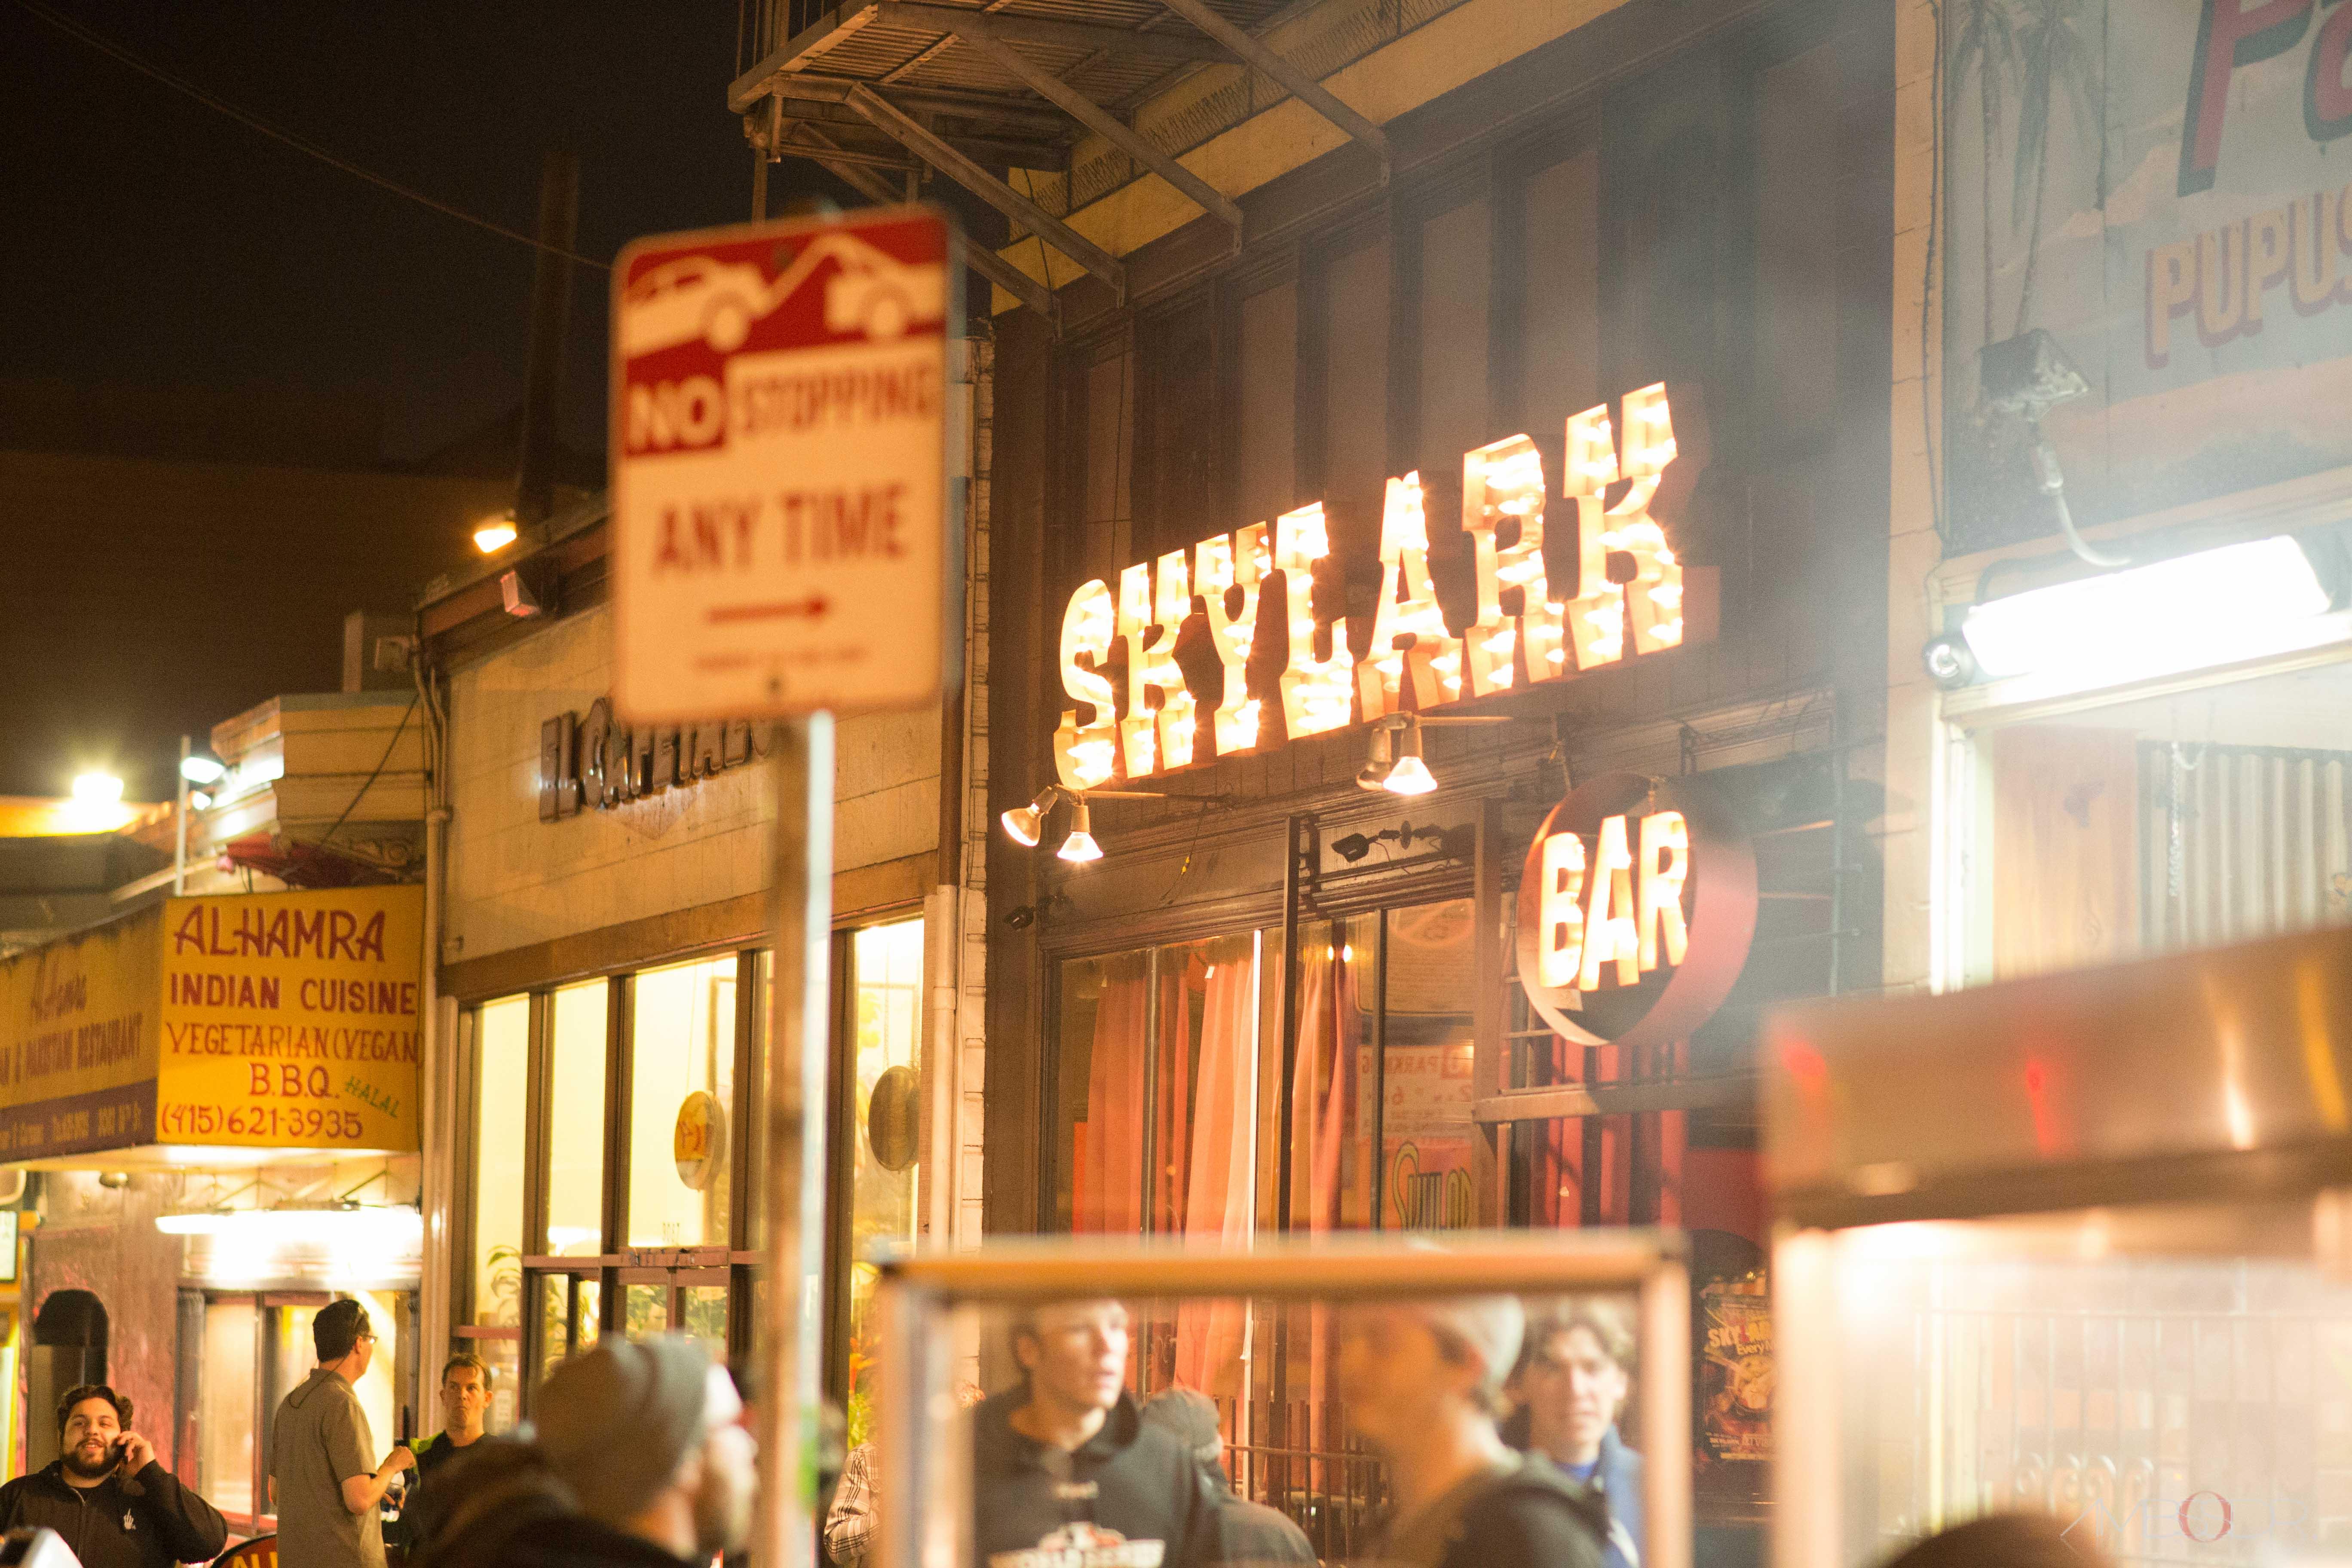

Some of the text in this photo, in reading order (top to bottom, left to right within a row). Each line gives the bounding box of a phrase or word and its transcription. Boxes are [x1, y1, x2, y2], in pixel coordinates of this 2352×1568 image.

[629, 375, 723, 450] NO
[651, 481, 904, 580] ANY TIME
[1054, 381, 1684, 790] SKYLARK
[1538, 810, 1689, 992] BAR
[174, 903, 386, 962] ALHAMRA
[170, 972, 418, 1016] INDIAN CUISINE
[248, 1063, 340, 1099] B.B.Q.
[344, 1075, 400, 1119] HALAL
[161, 1101, 363, 1139] (415)621-3935
[1708, 1320, 1773, 1348] SKYLAR
